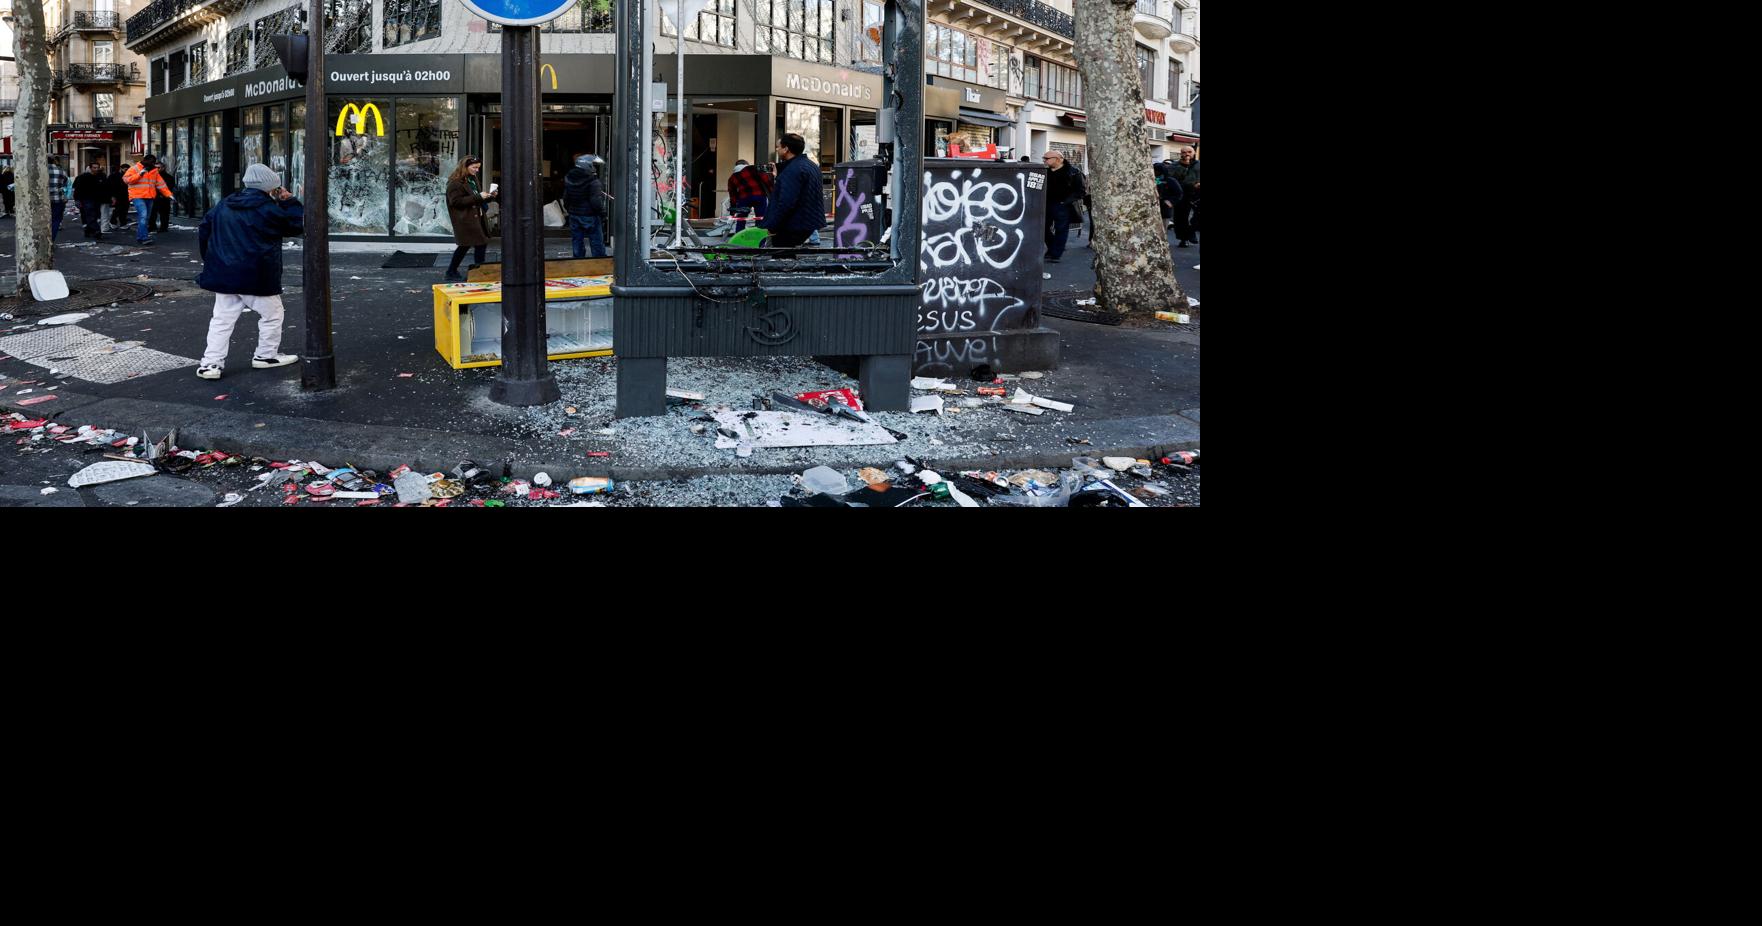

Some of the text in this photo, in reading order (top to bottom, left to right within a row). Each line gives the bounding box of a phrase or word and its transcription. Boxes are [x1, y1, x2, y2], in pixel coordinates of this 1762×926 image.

[330, 71, 369, 81] Ouvert
[414, 70, 451, 81] 02h00
[786, 72, 871, 100] McDonald's
